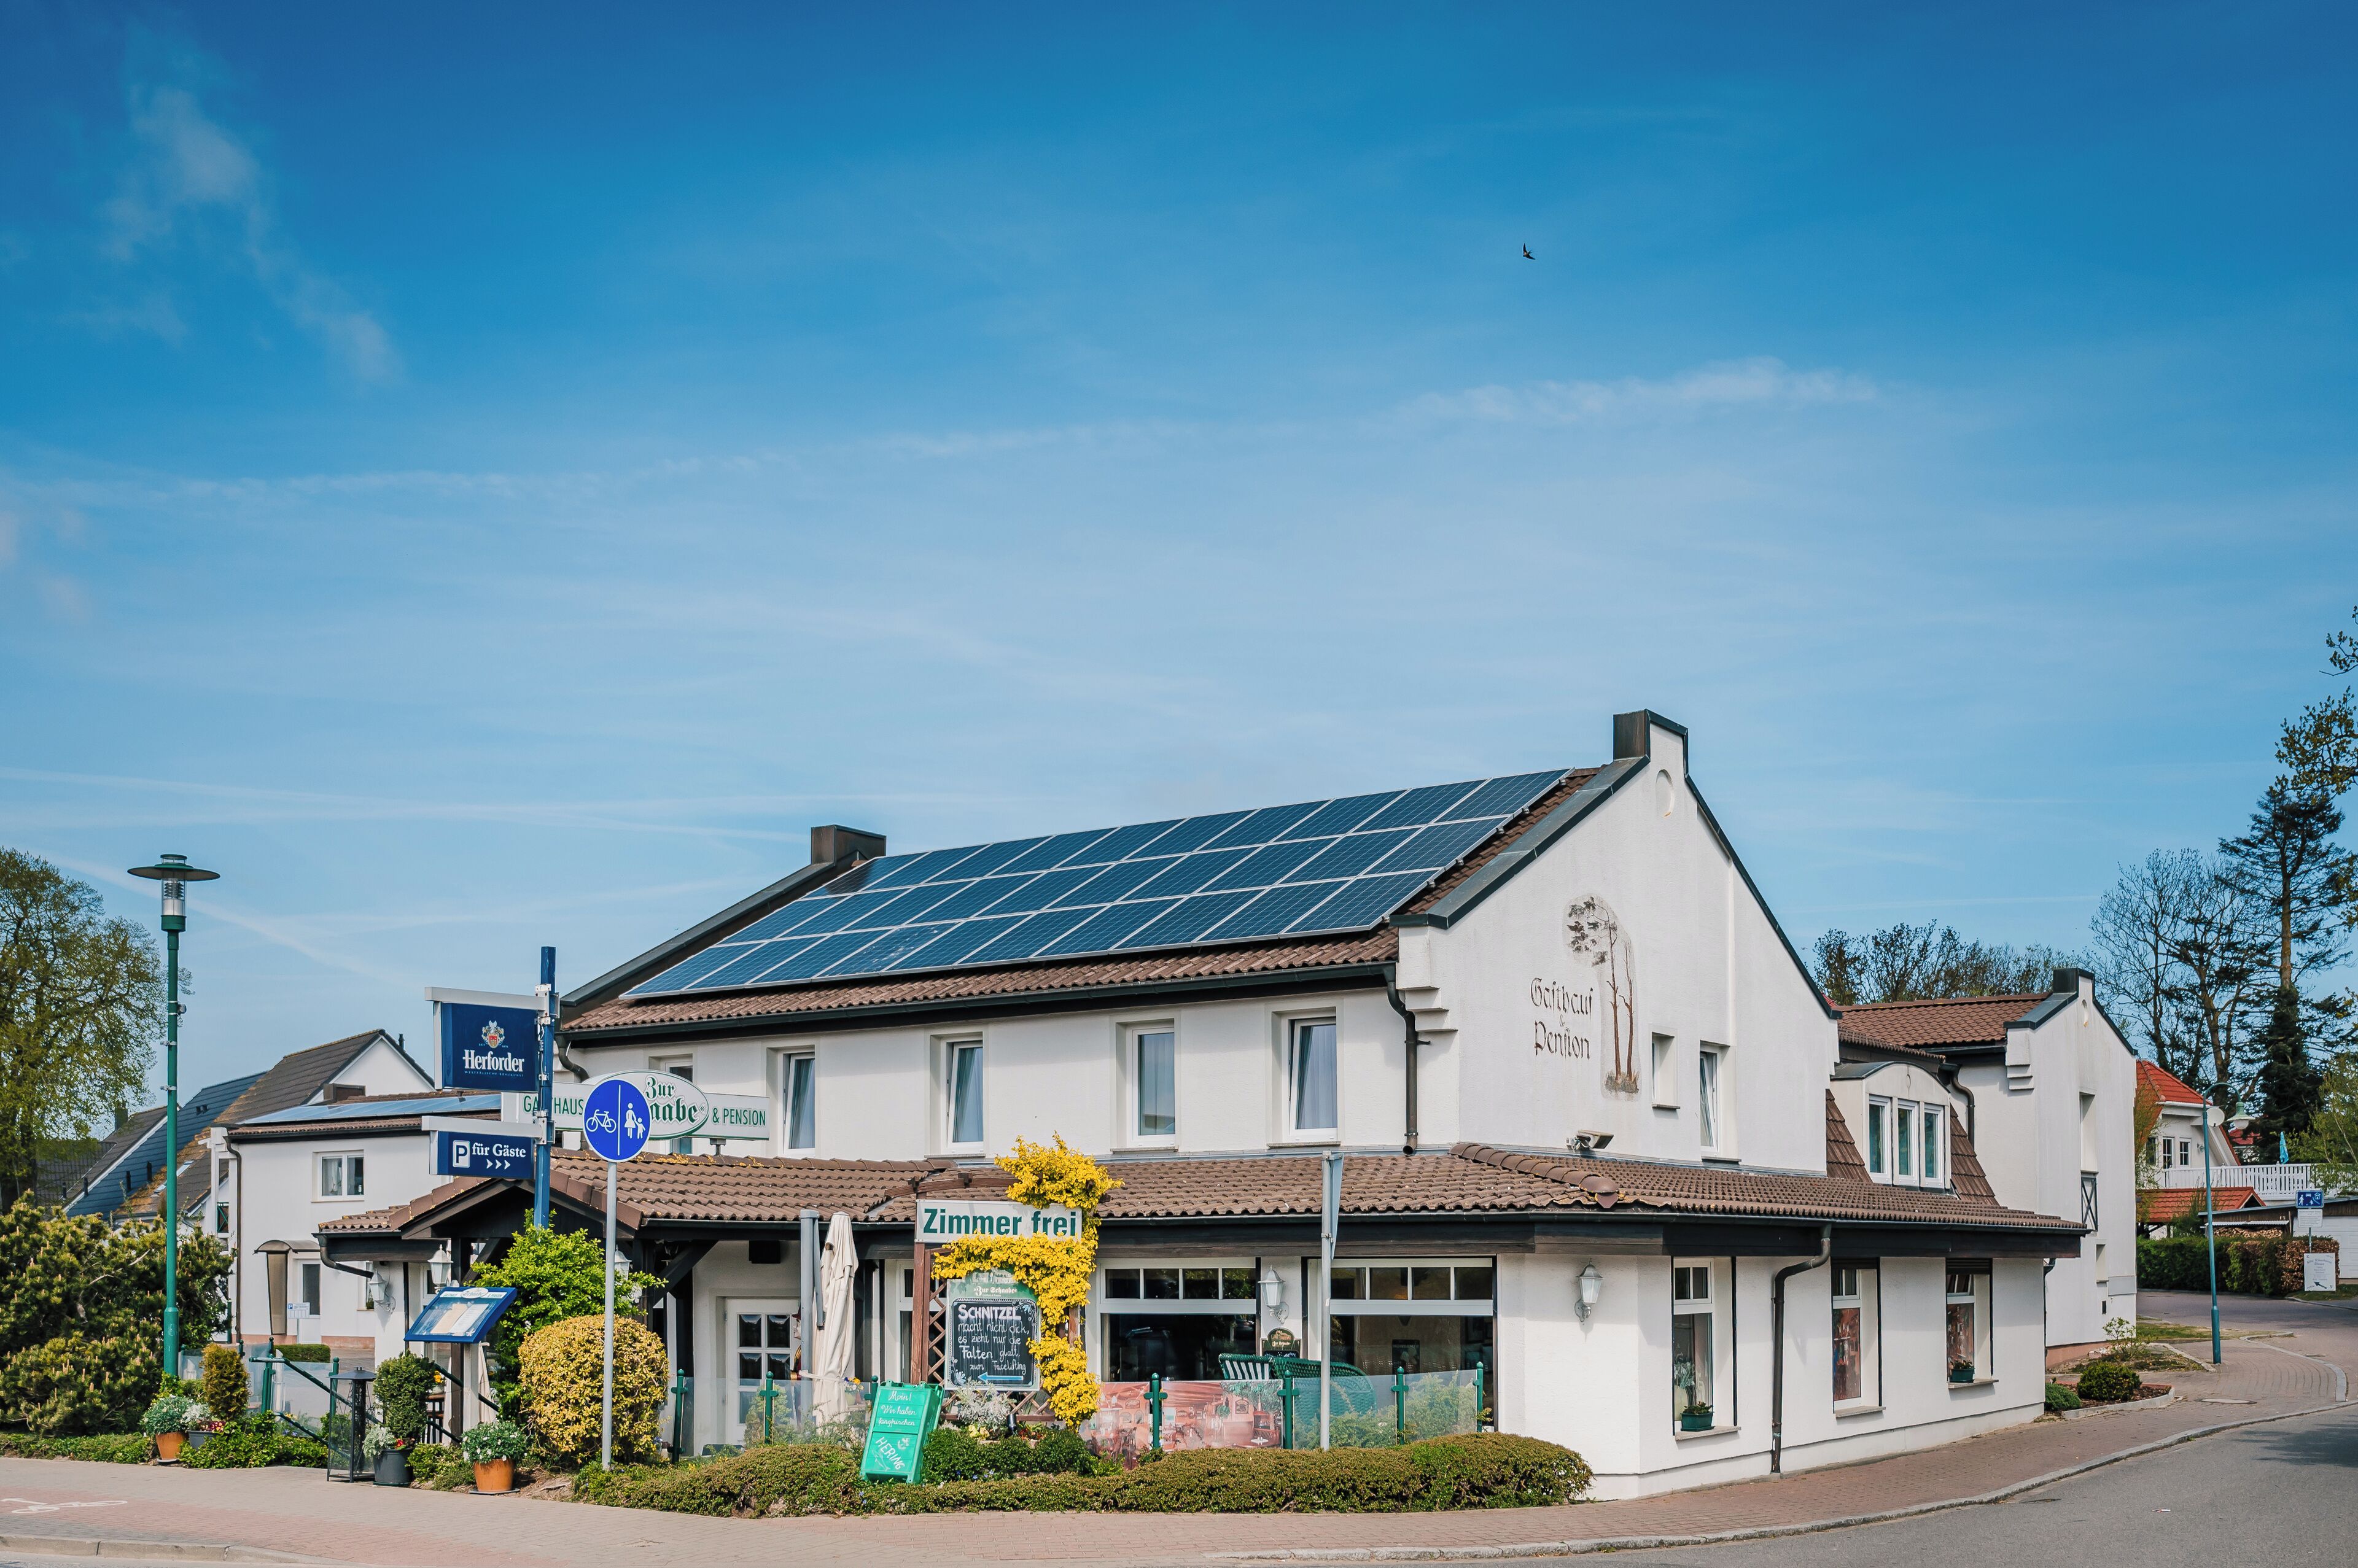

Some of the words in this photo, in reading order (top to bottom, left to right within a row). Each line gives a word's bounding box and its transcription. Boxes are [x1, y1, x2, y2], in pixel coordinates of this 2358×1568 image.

[462, 1049, 524, 1072] Herforder
[646, 1076, 675, 1099] Zur
[524, 1095, 583, 1116] GAHAUS
[713, 1108, 720, 1123] &
[723, 1108, 766, 1126] PENSION
[472, 1142, 489, 1155] für
[492, 1143, 526, 1157] Gäste
[923, 1208, 1022, 1235] Zimmer
[1031, 1211, 1076, 1236] frei
[958, 1303, 1022, 1321] SCHNITZEL
[958, 1321, 982, 1332] macht
[986, 1321, 1007, 1332] nicht
[1009, 1321, 1029, 1335] dick,
[958, 1335, 968, 1344] es
[971, 1333, 989, 1343] zieht
[992, 1335, 1006, 1344] nur
[1009, 1332, 1021, 1345] die
[959, 1345, 993, 1359] Falten
[992, 1359, 1027, 1375] Facelifting
[888, 1390, 912, 1401] Moin!
[881, 1404, 897, 1415] Wir
[897, 1405, 916, 1416] haben
[875, 1436, 905, 1470] HERING
